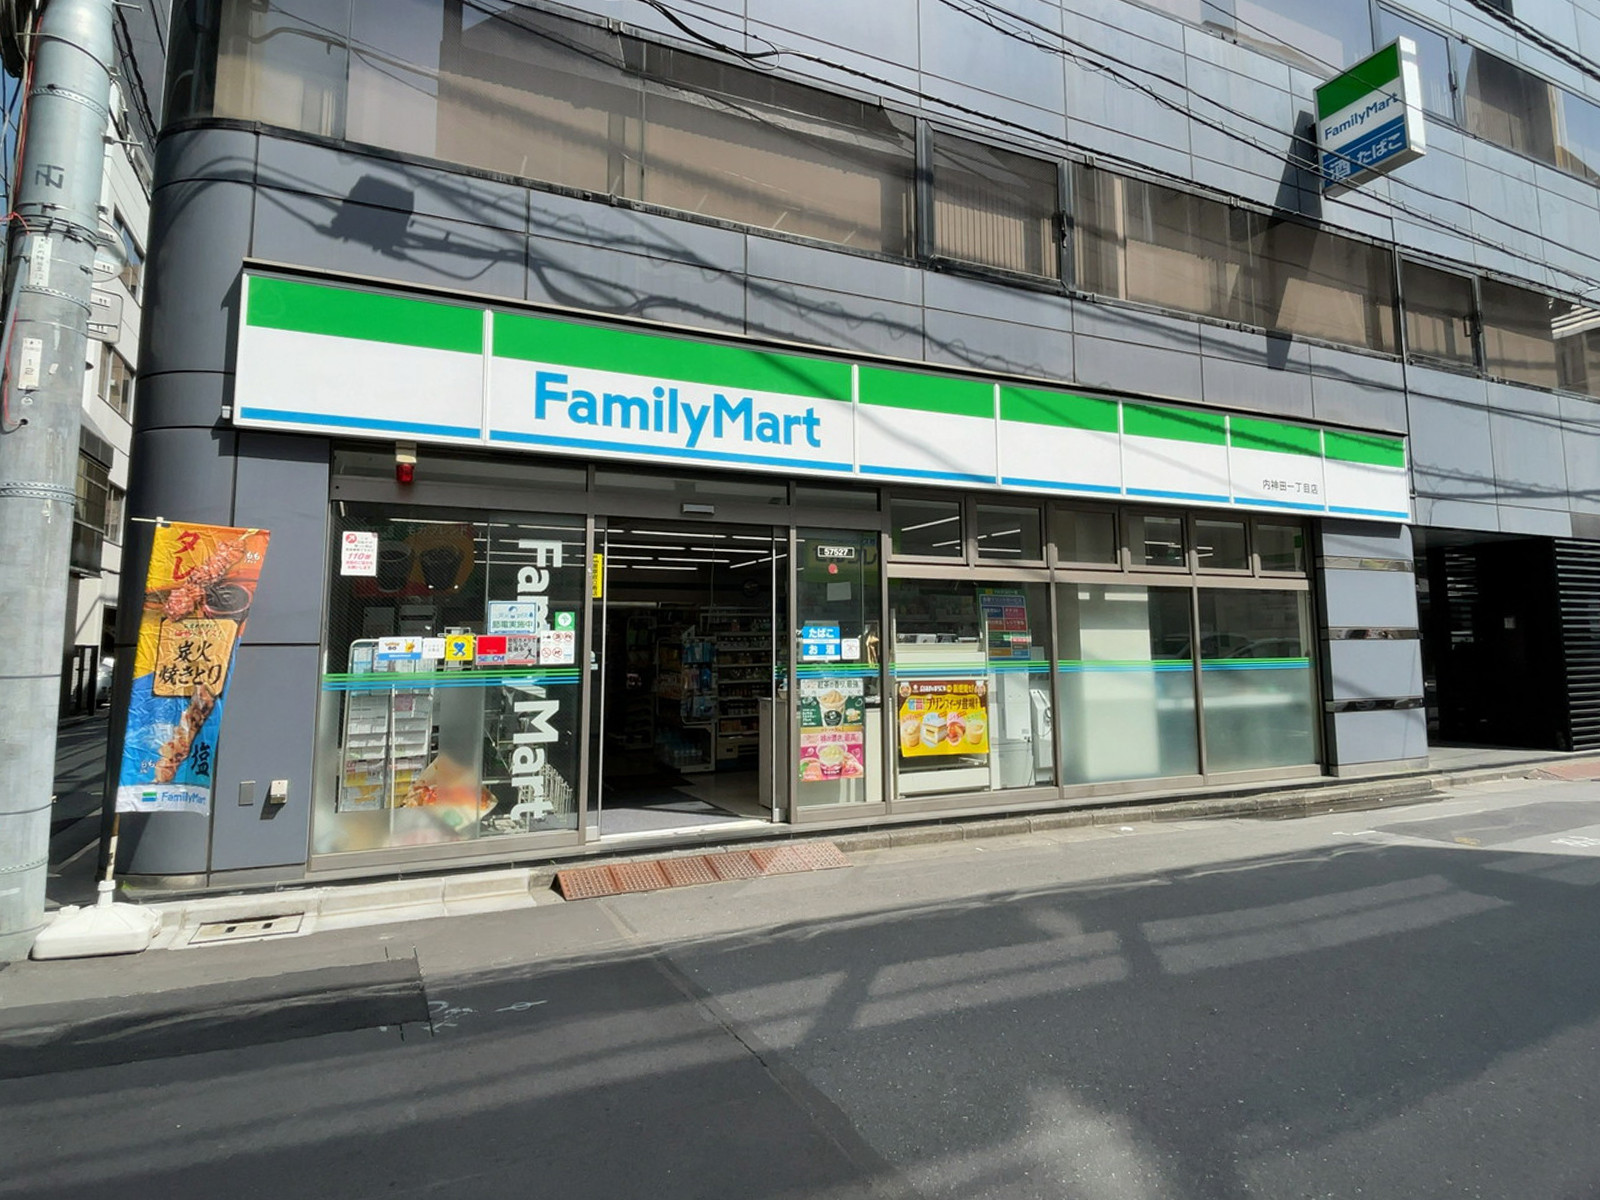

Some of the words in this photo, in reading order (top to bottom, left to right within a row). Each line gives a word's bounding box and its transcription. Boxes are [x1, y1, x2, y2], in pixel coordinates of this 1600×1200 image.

[1325, 92, 1398, 140] FamilyMart
[1357, 133, 1402, 164] たばこ
[535, 371, 821, 448] FamilyMart
[1263, 479, 1318, 494] 内神田一丁目店
[174, 531, 200, 581] タレ
[823, 548, 849, 556] 57527
[808, 628, 834, 638] たばこ
[173, 640, 212, 662] 炭火
[159, 663, 222, 686] 焼きとり
[191, 741, 210, 777] 塩
